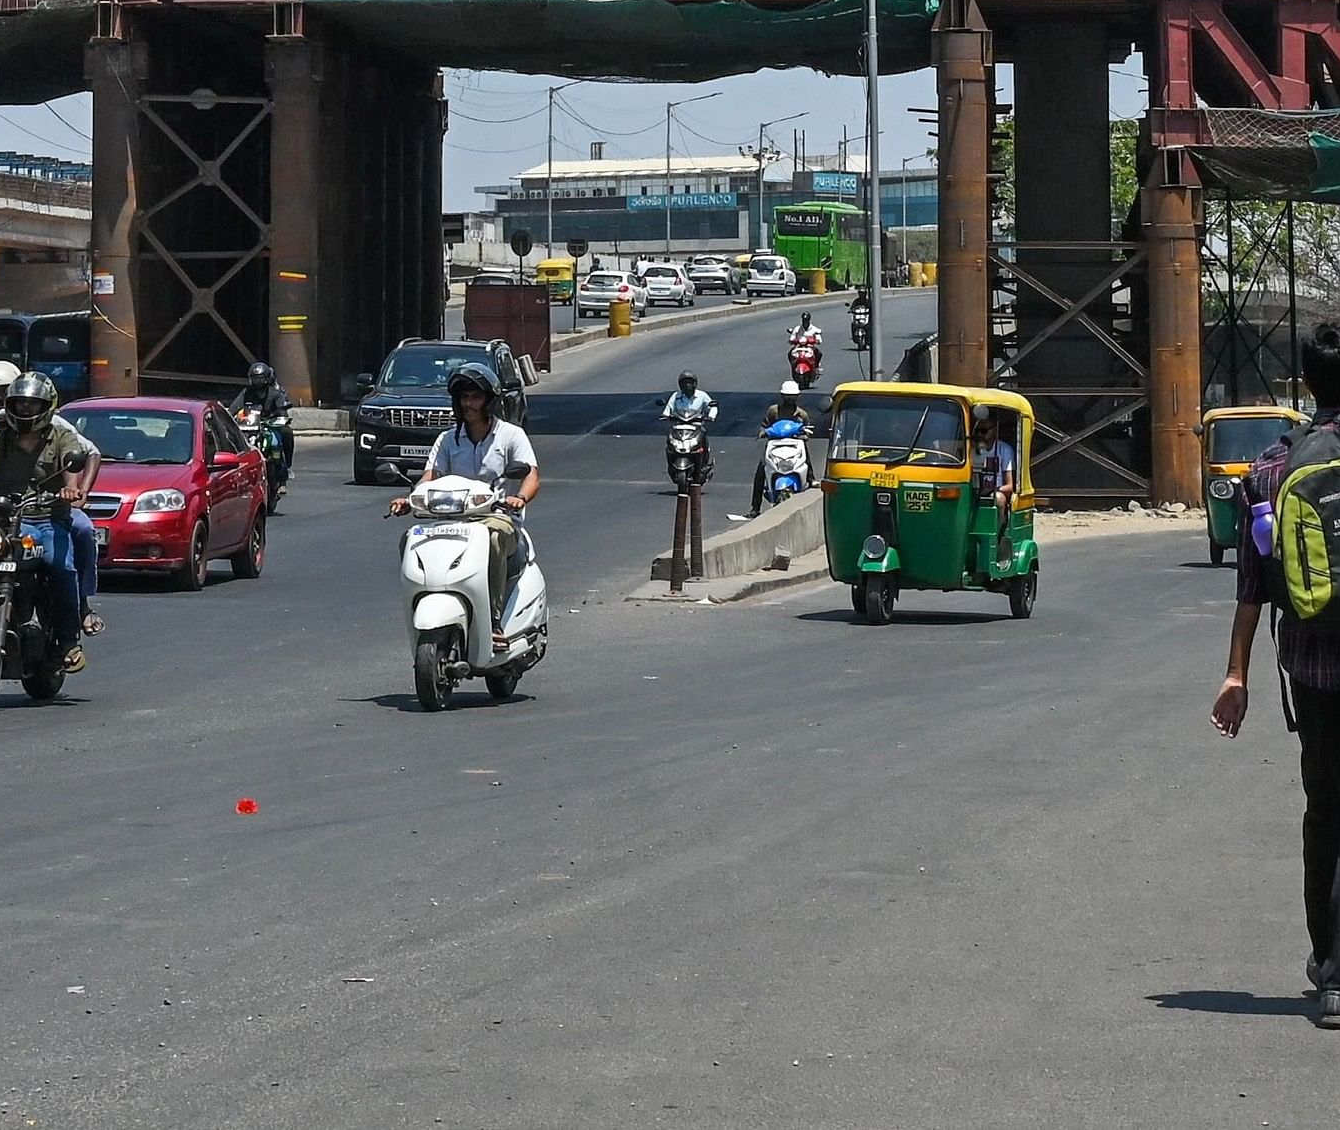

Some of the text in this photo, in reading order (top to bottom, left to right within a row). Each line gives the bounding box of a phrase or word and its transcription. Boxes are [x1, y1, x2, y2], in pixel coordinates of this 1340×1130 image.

[814, 176, 857, 189] FURLENCO
[671, 195, 732, 206] FURLENCO
[906, 492, 930, 502] KA05
